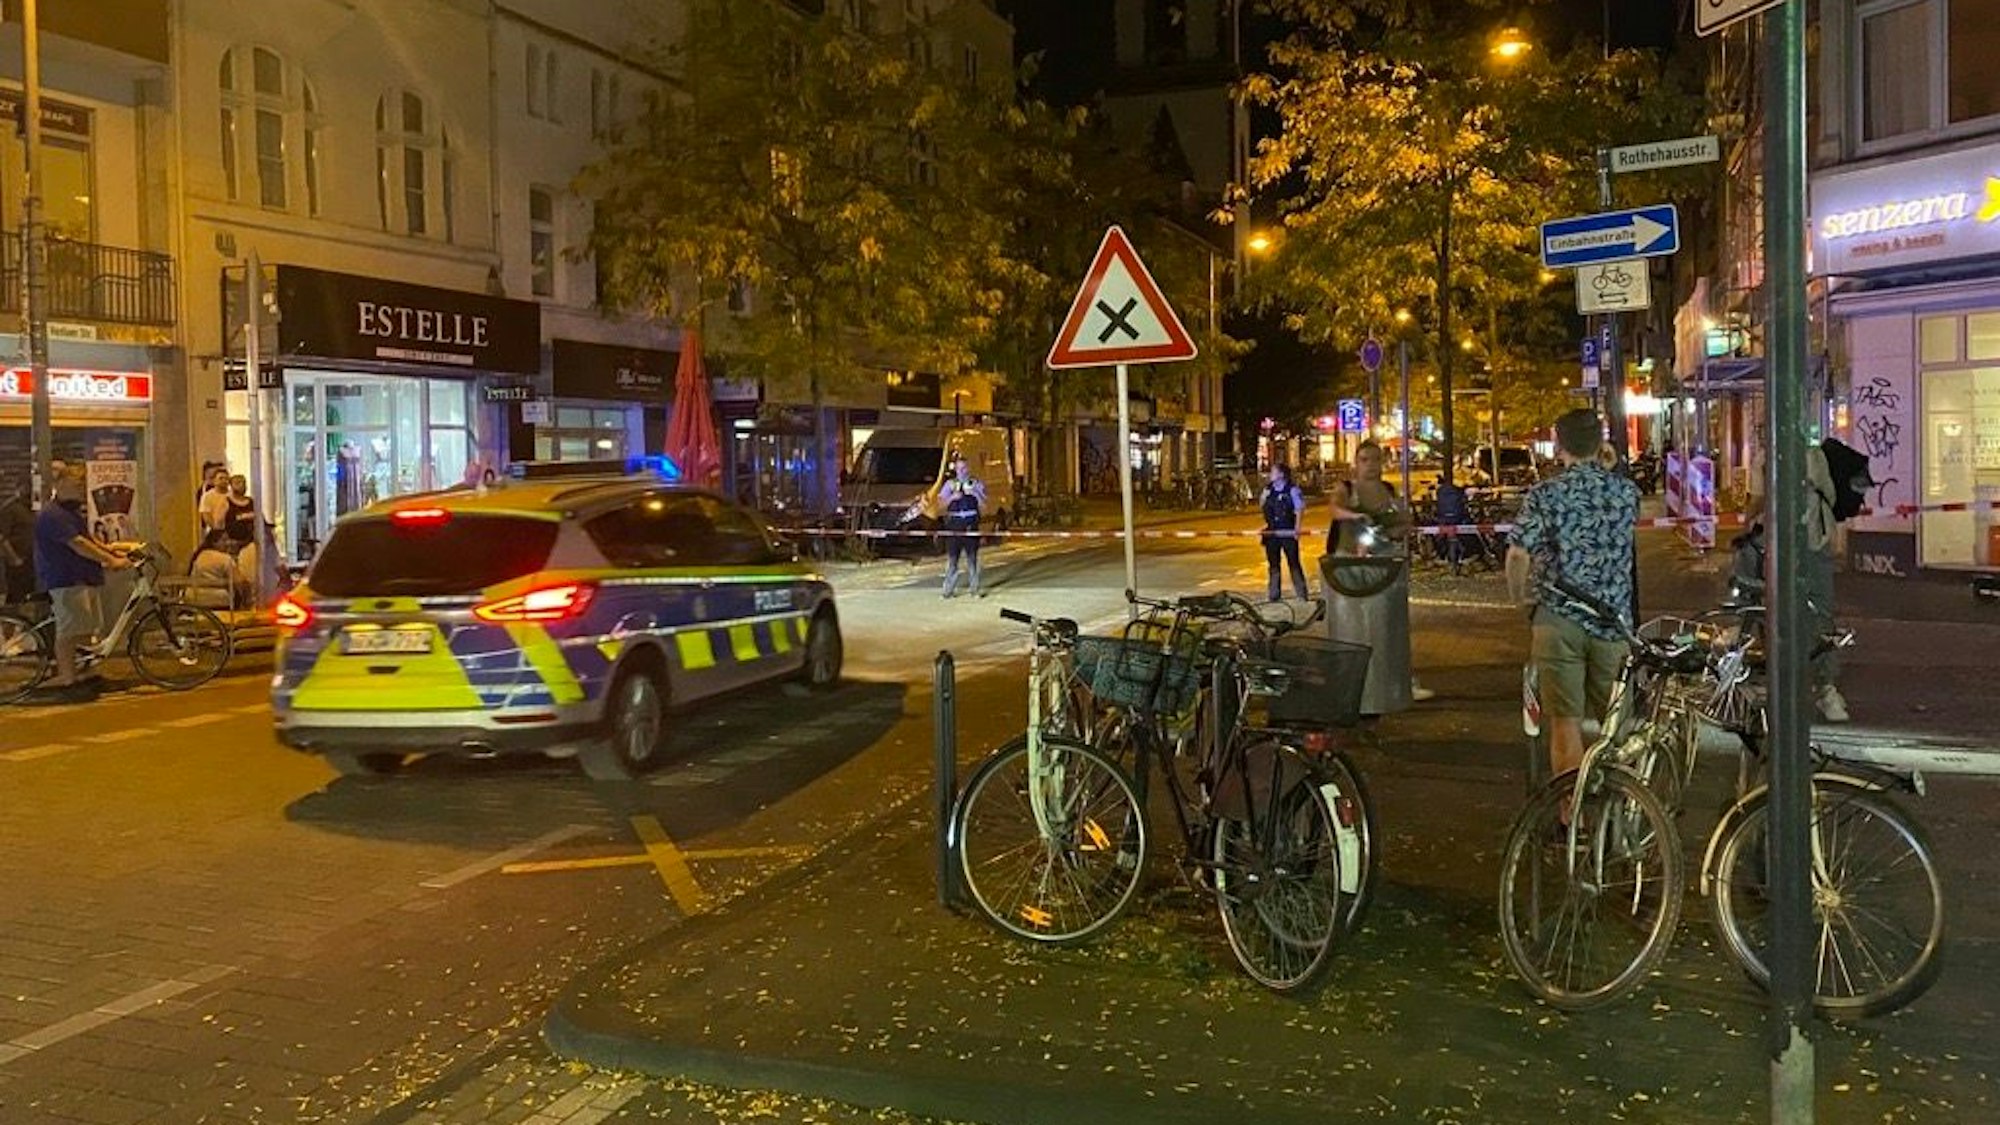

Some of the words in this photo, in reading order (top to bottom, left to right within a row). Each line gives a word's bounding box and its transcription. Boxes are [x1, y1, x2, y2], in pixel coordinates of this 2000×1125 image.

[1619, 143, 1712, 167] Rothehausstr.
[1822, 192, 1968, 239] senzera
[1551, 230, 1635, 250] Einbahnstraße
[358, 301, 489, 347] ESTELLE
[49, 374, 126, 396] nited
[1344, 407, 1357, 424] P
